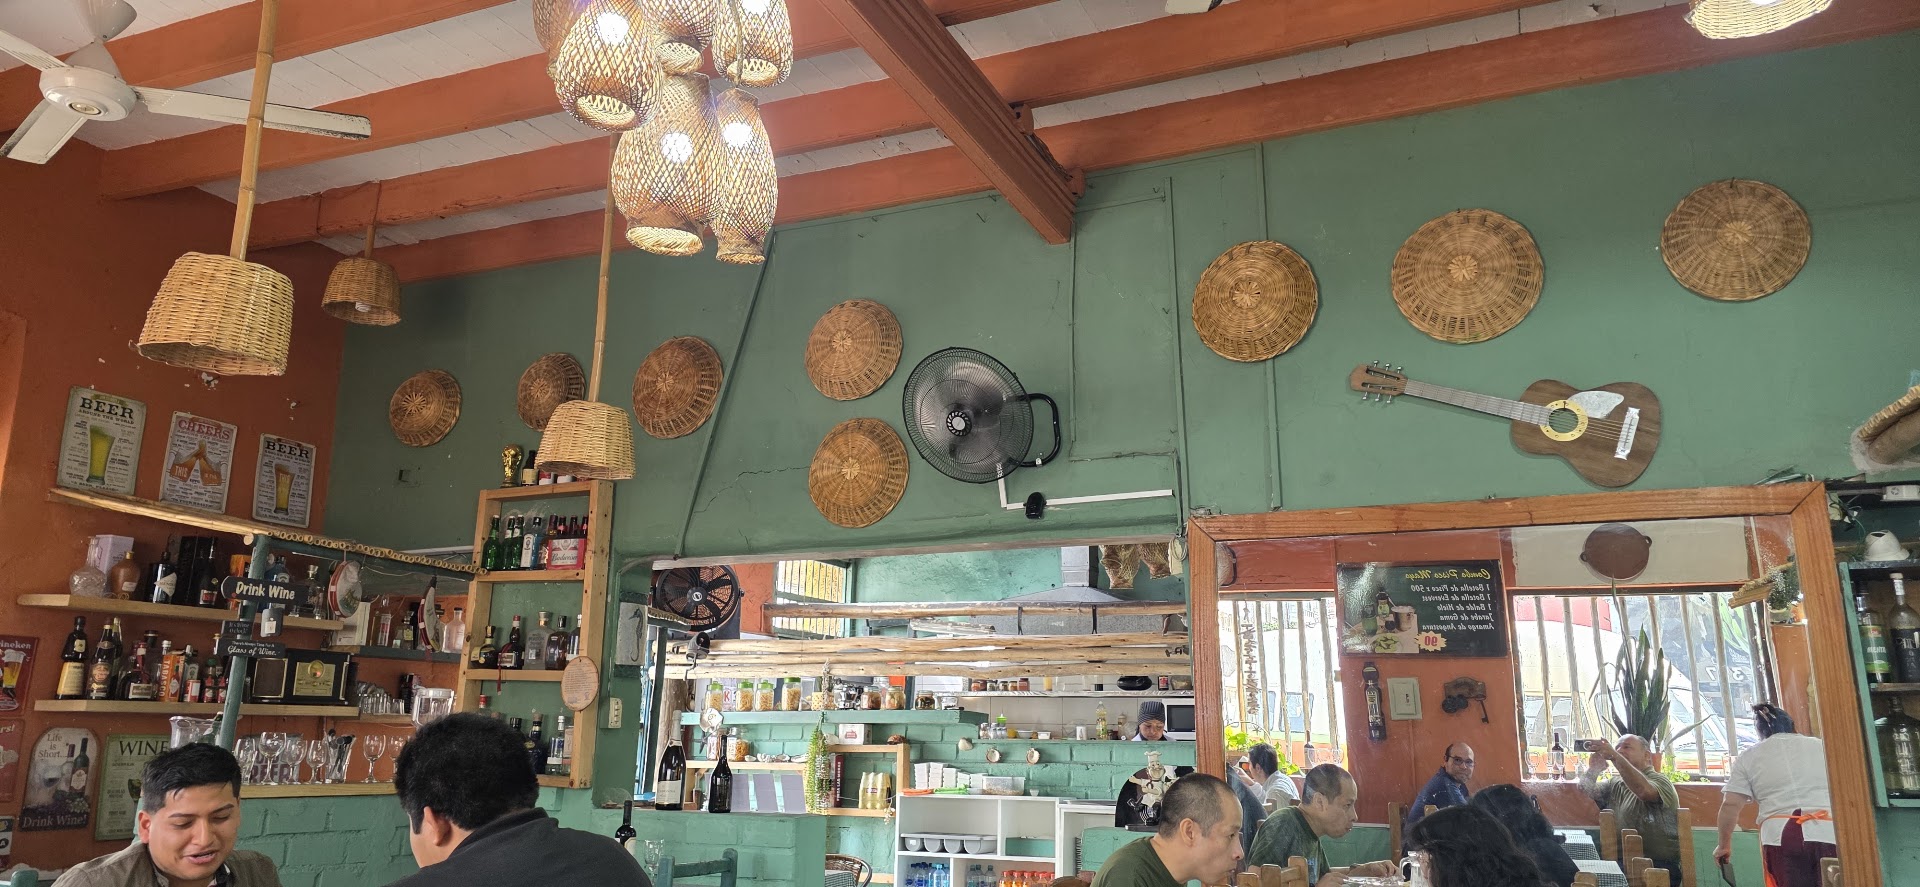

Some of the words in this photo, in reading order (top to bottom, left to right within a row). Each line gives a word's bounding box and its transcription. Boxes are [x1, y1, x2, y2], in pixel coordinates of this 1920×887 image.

[80, 396, 134, 419] BEER
[115, 416, 135, 425] WORLD
[178, 420, 230, 440] CHEERS
[266, 440, 309, 458] BEER
[175, 465, 188, 478] THIS
[236, 582, 265, 596] Drink
[268, 585, 295, 600] Wine
[0, 640, 31, 649] ineken
[228, 646, 246, 654] Glass
[248, 647, 257, 656] of
[159, 660, 170, 697] TABASCO
[48, 734, 62, 742] Life
[50, 742, 57, 750] is
[23, 816, 54, 828] Drink
[57, 814, 87, 826] Wine!
